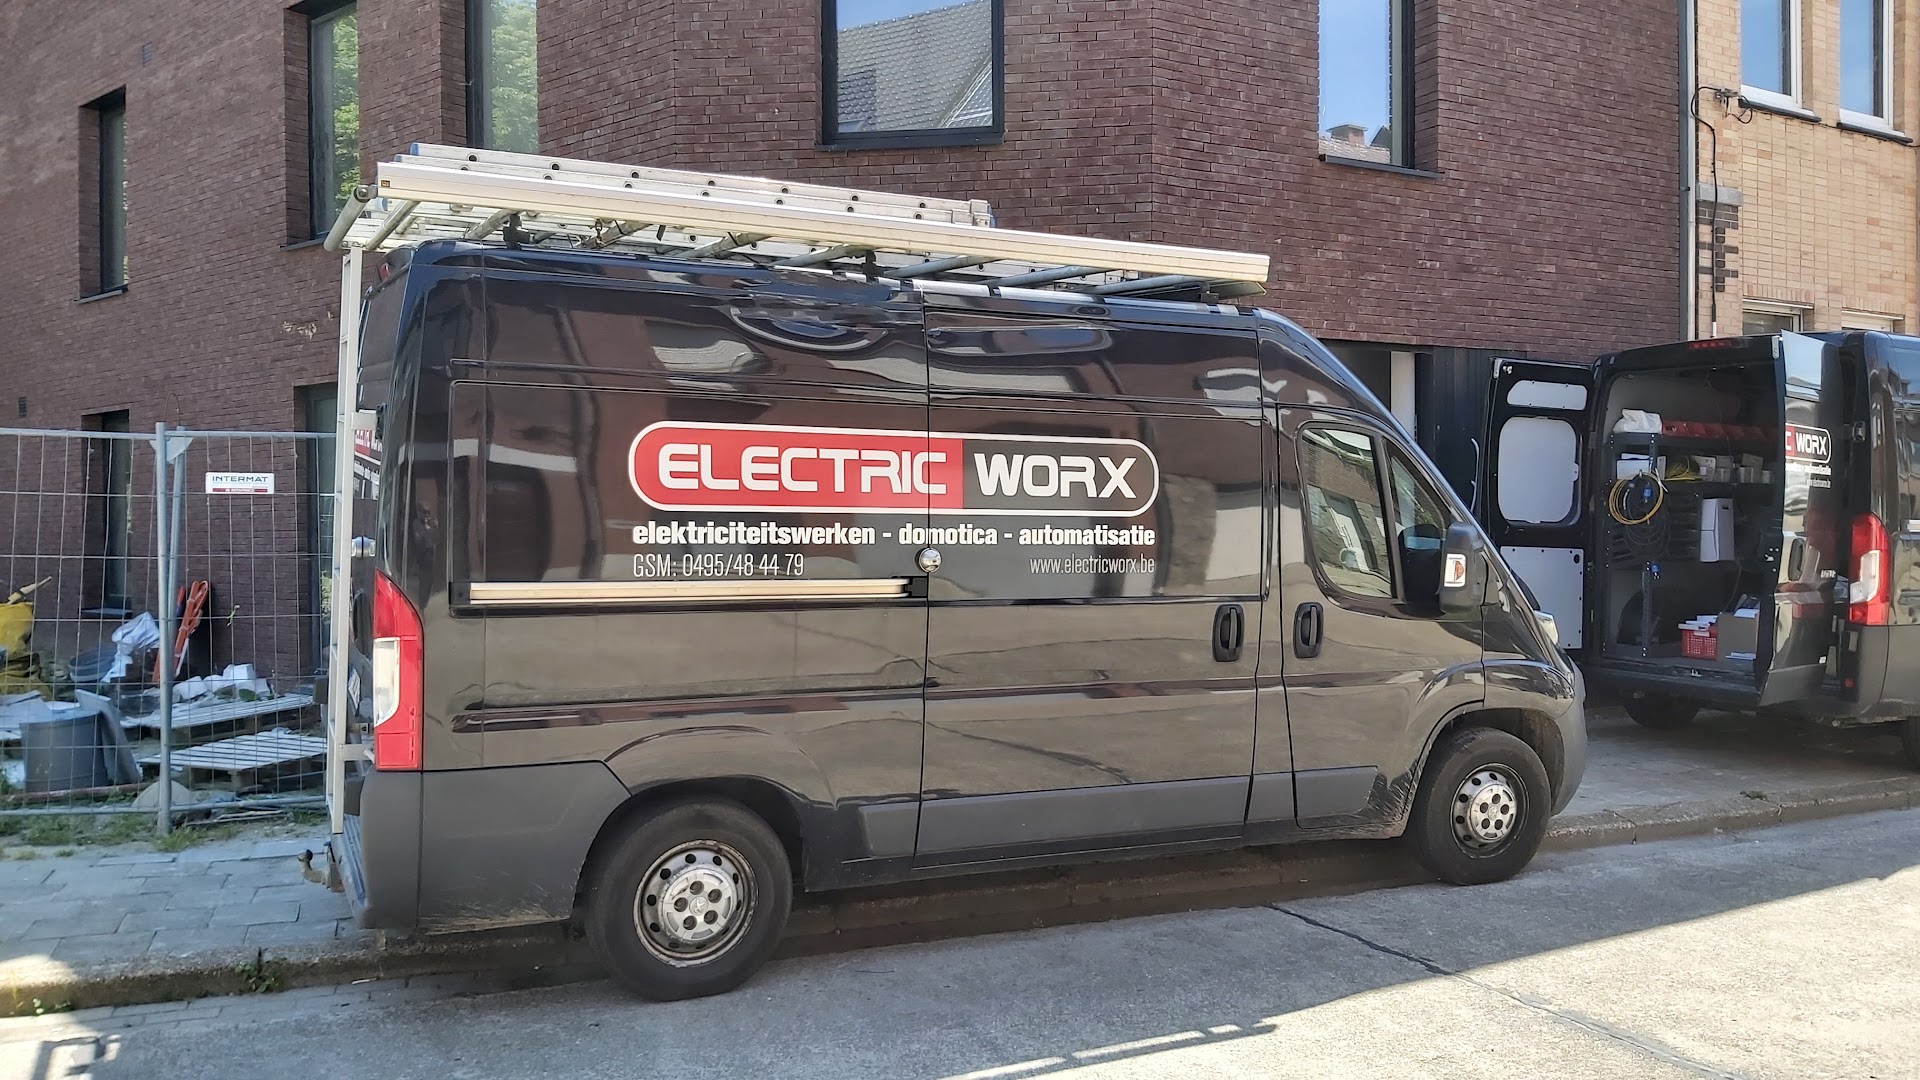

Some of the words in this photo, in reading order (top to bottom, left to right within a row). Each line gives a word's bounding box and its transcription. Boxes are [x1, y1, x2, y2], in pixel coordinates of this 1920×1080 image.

[1795, 432, 1827, 456] WORX
[212, 475, 268, 483] INTERMAT
[658, 443, 947, 495] ELECTRIC
[973, 452, 1137, 499] WORX
[632, 520, 876, 545] elektriciteitswerken
[898, 522, 998, 545] domotica
[1018, 524, 1156, 546] automatisatie
[633, 553, 677, 577] GSM:
[682, 553, 754, 577] 0495/48
[759, 554, 780, 576] 44
[785, 553, 804, 576] 79
[1030, 553, 1156, 574] www.electricworx.be
